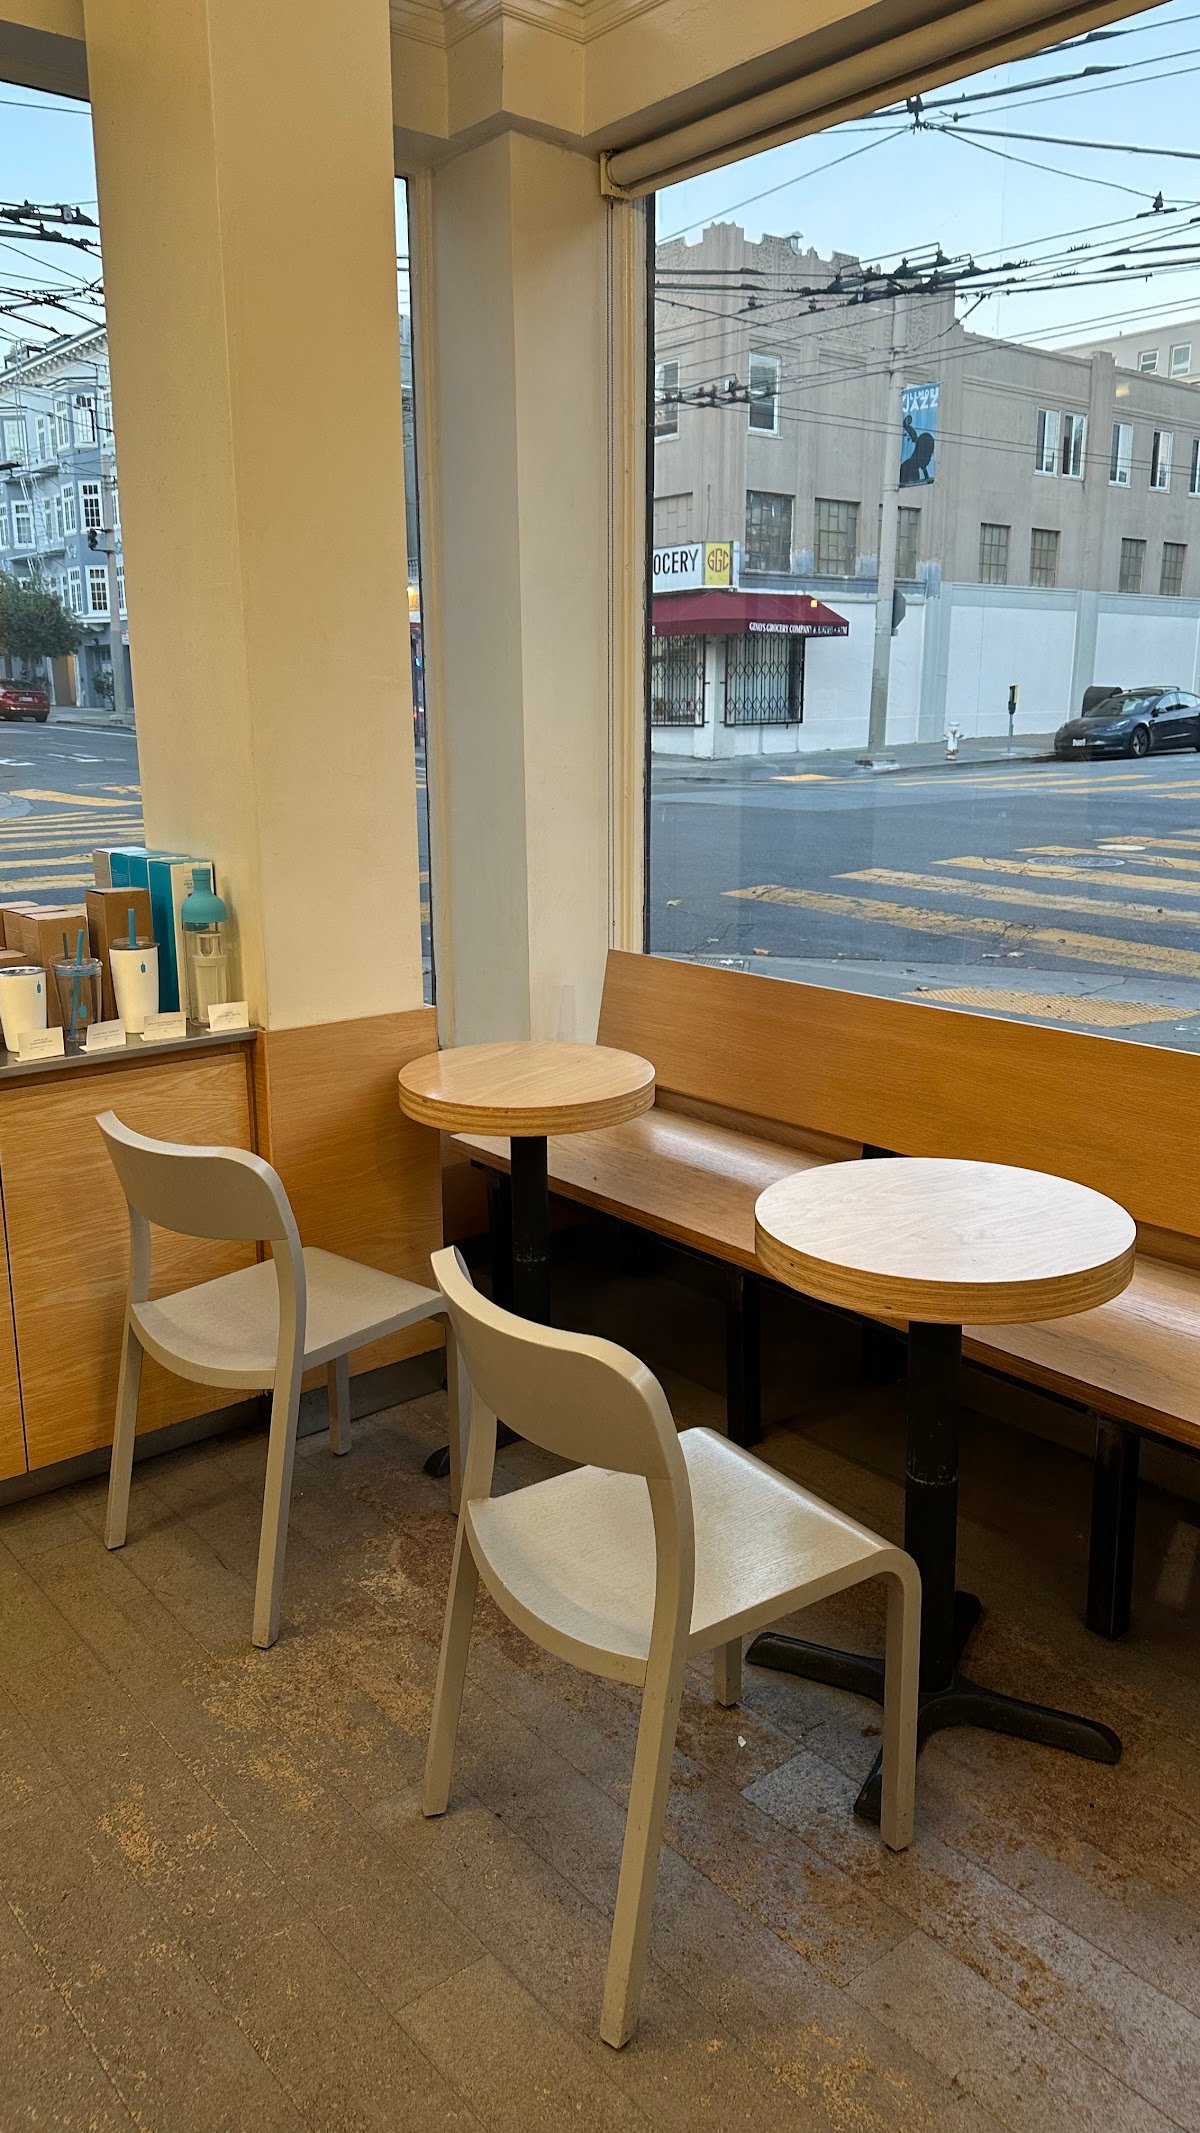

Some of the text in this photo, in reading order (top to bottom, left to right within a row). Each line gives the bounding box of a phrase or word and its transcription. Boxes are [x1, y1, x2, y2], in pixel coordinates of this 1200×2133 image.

[902, 392, 939, 413] JAZZ
[653, 548, 699, 576] OCERY
[707, 548, 729, 573] GGC
[749, 621, 766, 632] GINO'S
[766, 623, 789, 633] GROCERY
[789, 624, 812, 634] COMPANY
